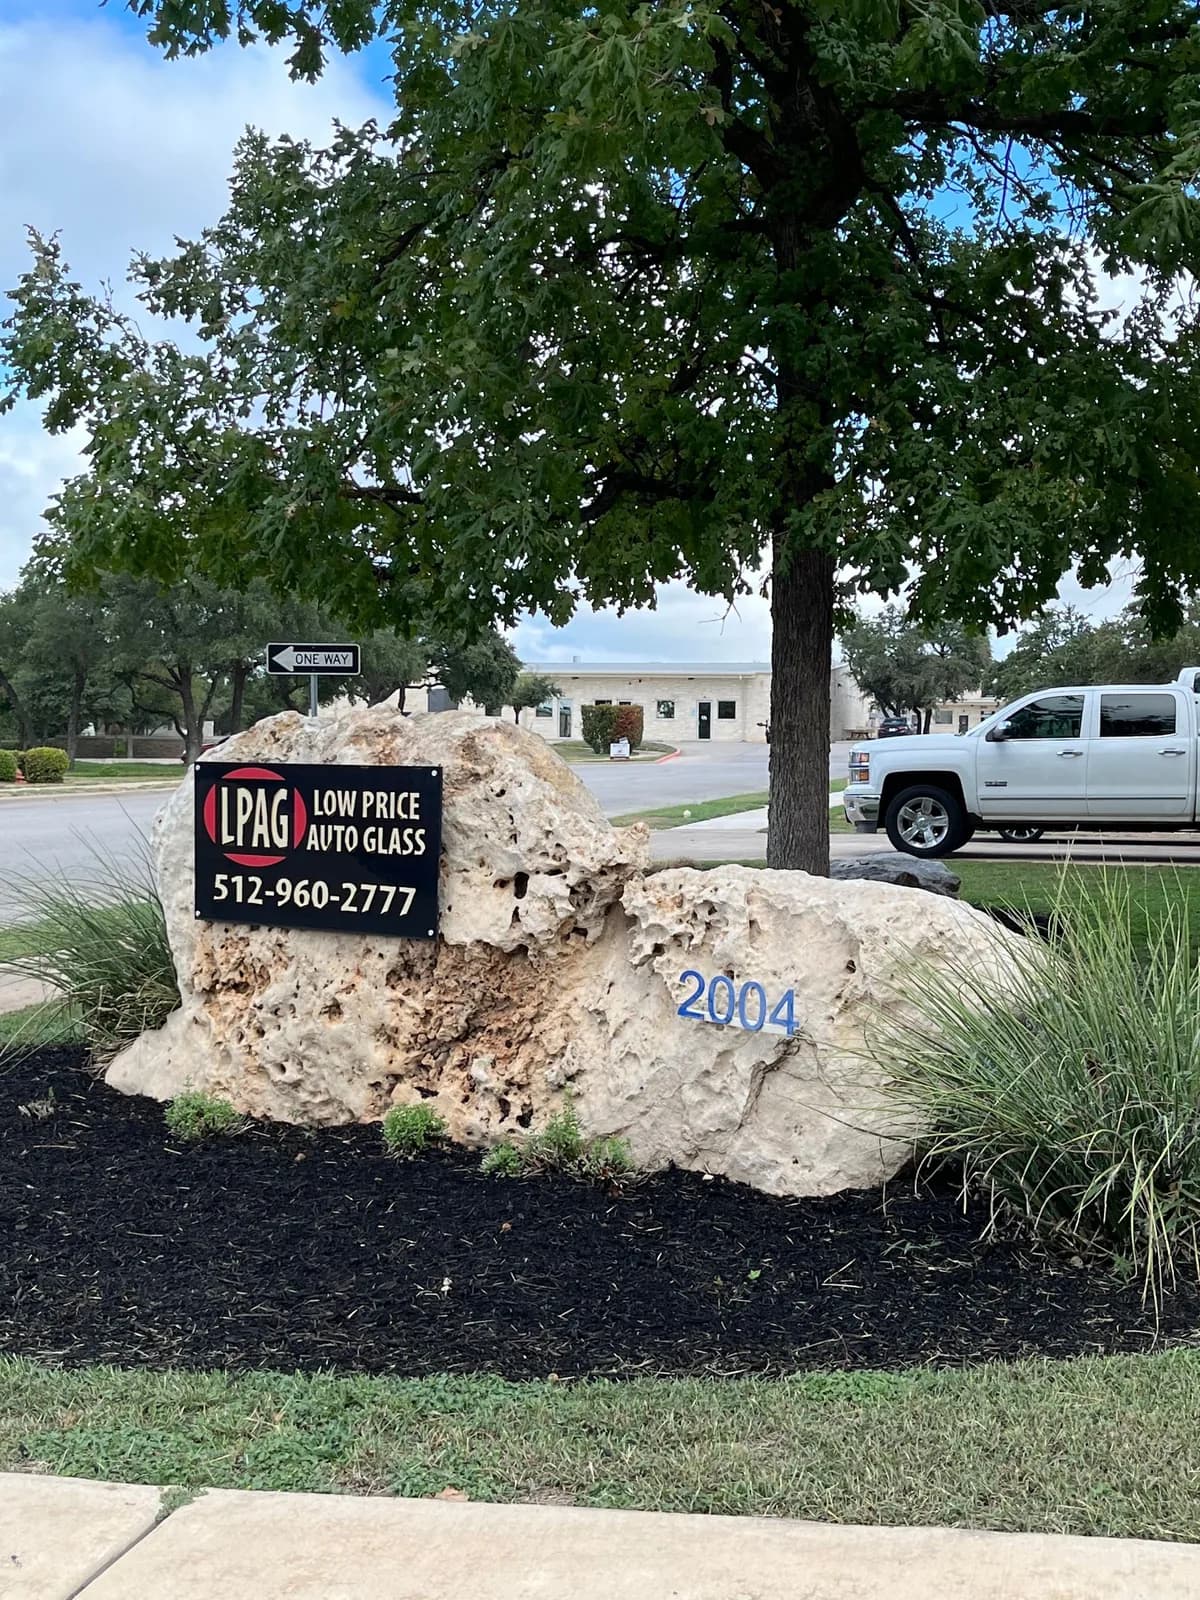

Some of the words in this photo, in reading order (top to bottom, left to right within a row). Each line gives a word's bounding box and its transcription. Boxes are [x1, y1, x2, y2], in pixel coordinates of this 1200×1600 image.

[295, 653, 320, 665] ONE
[324, 653, 349, 665] WAY
[220, 786, 288, 848] LPAG
[313, 789, 356, 817] LOW
[362, 790, 420, 821] PRICE
[306, 824, 358, 853] AUTO
[363, 827, 426, 856] GLASS
[213, 874, 416, 916] 512-960-2777
[677, 969, 799, 1037] 2004
